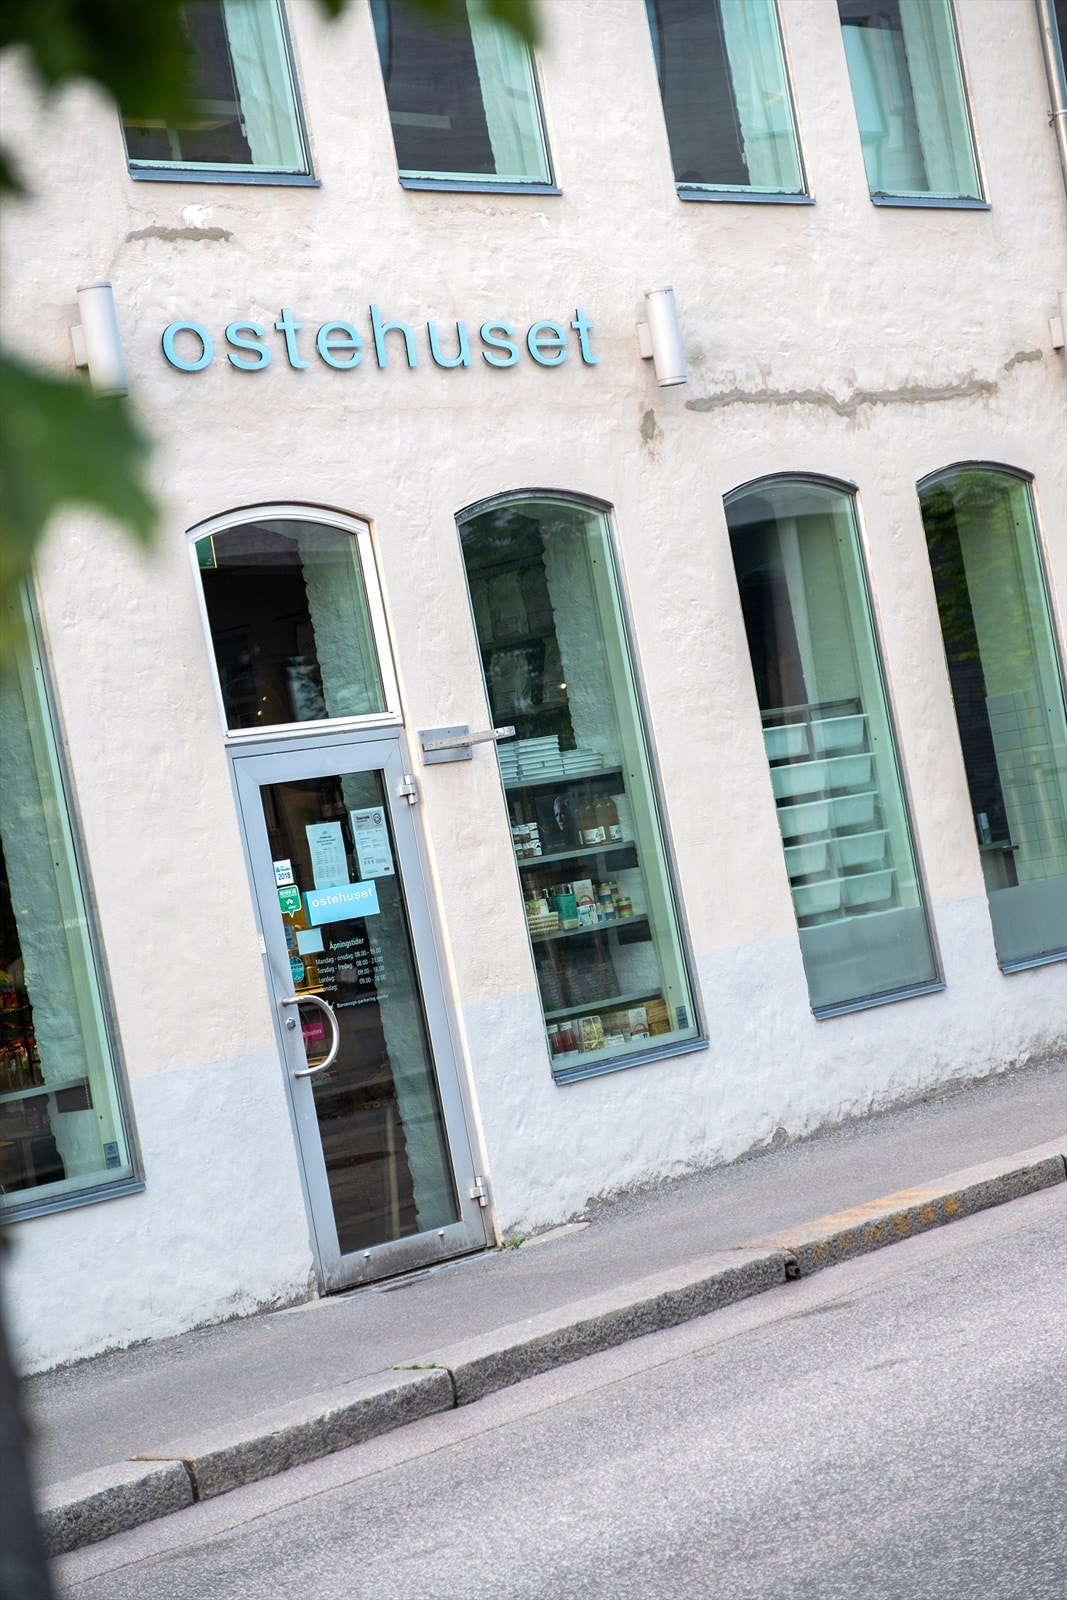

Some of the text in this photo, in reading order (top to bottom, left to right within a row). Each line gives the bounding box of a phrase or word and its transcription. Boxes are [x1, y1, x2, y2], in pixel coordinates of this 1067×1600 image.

[161, 305, 600, 372] ostehuset
[278, 872, 291, 880] 2018
[311, 889, 373, 907] ostehuset
[330, 938, 364, 949] Åpningstider
